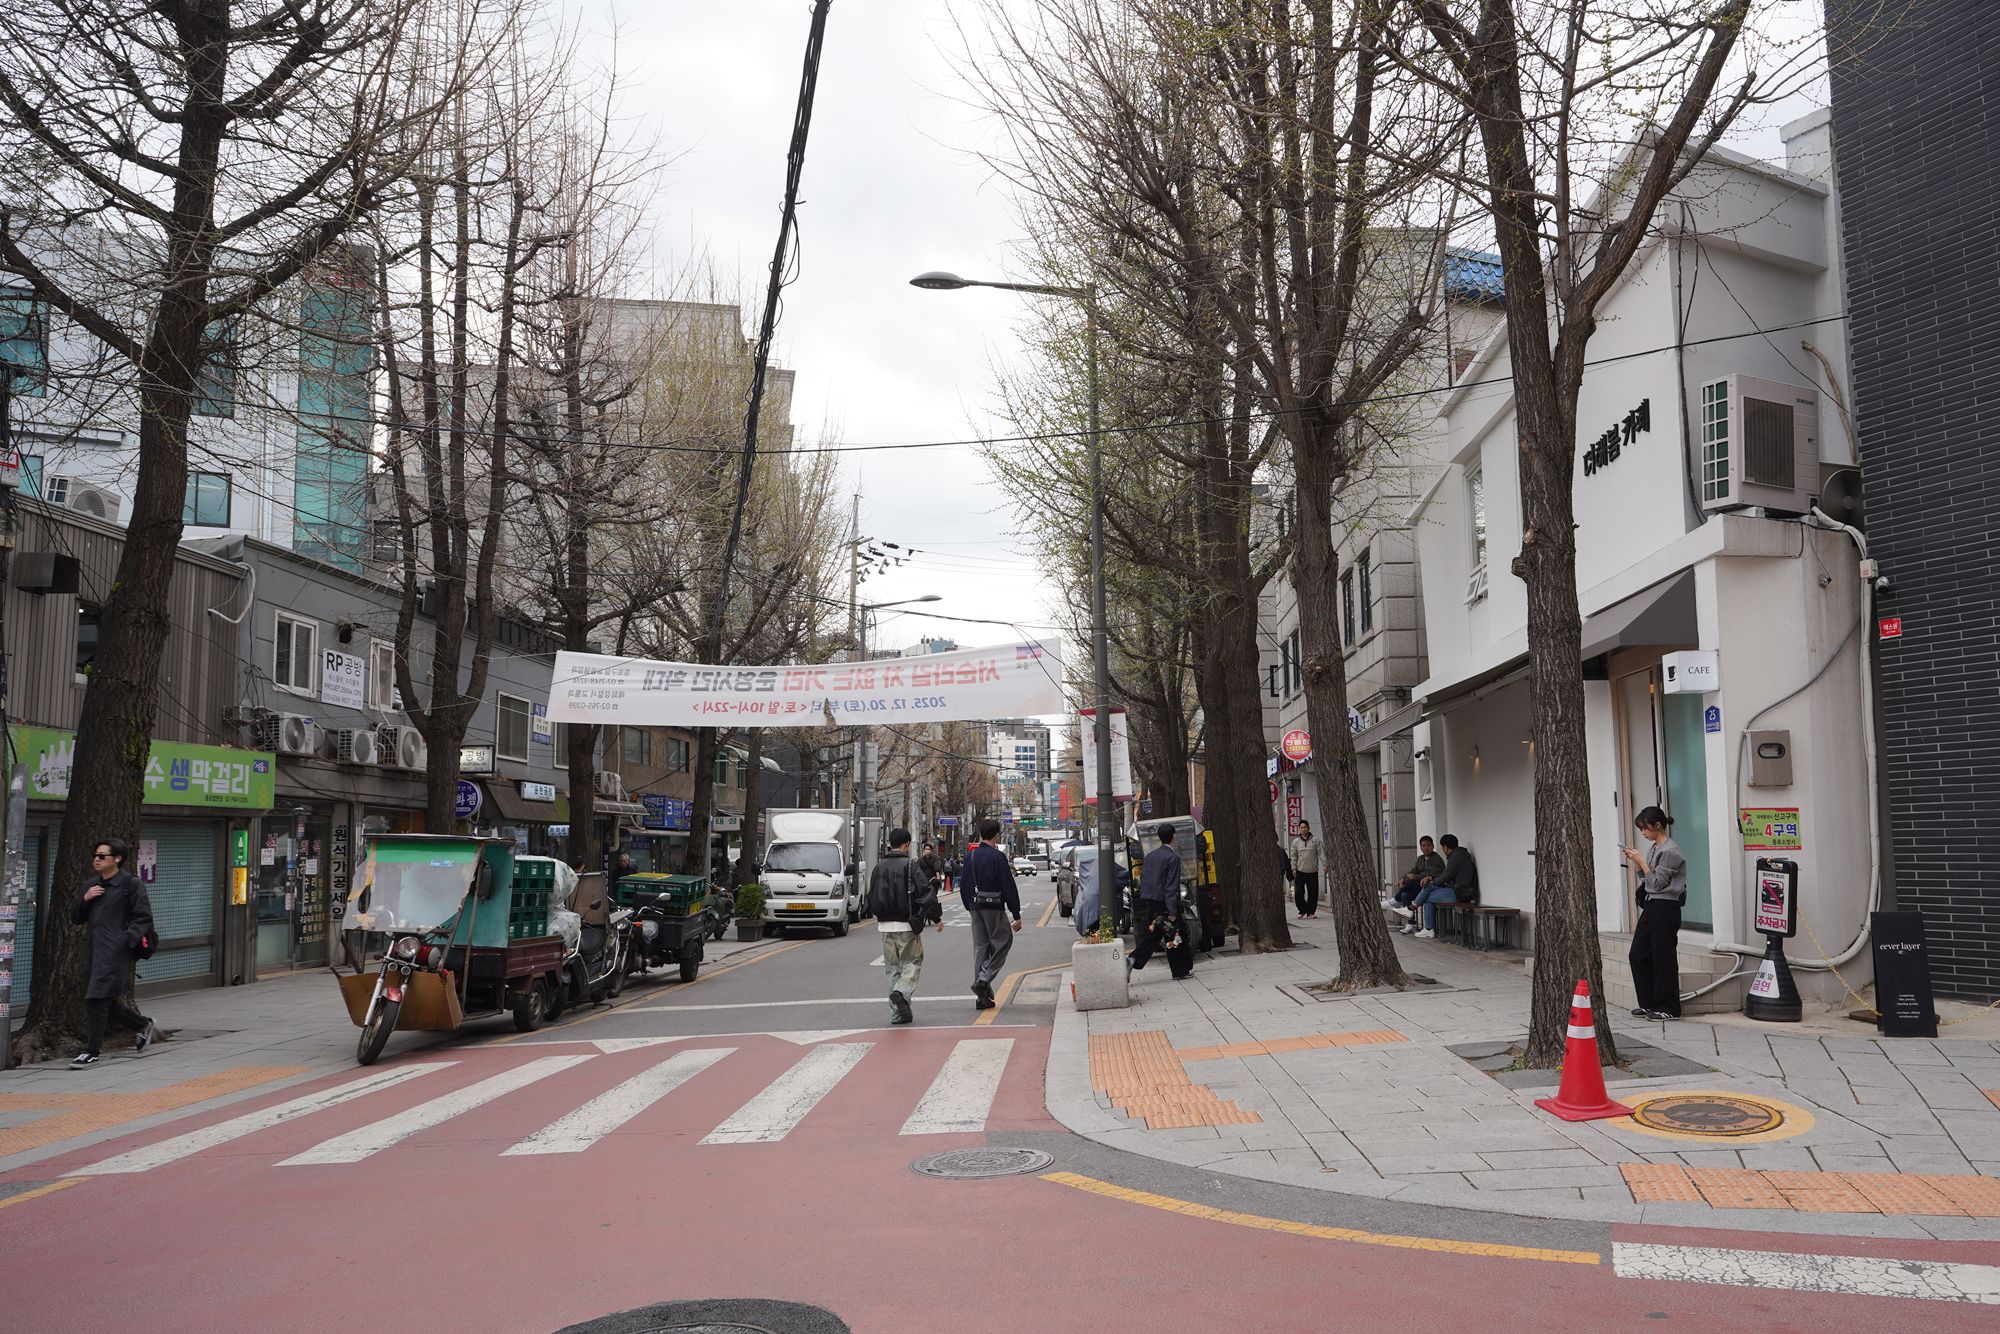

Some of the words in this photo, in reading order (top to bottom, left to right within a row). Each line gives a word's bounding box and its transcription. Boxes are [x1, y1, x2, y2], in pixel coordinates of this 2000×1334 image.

[326, 652, 344, 672] RP
[344, 657, 362, 677] 공방
[1687, 665, 1711, 675] CAFE
[1709, 709, 1716, 721] 25
[465, 750, 485, 762] 공방
[170, 758, 250, 795] 생막걸리
[1774, 812, 1797, 821] 신고구역
[1765, 823, 1797, 837] 4구역
[1757, 915, 1787, 929] 주차금지
[1900, 942, 1921, 952] layer
[1753, 979, 1772, 993] 금연
